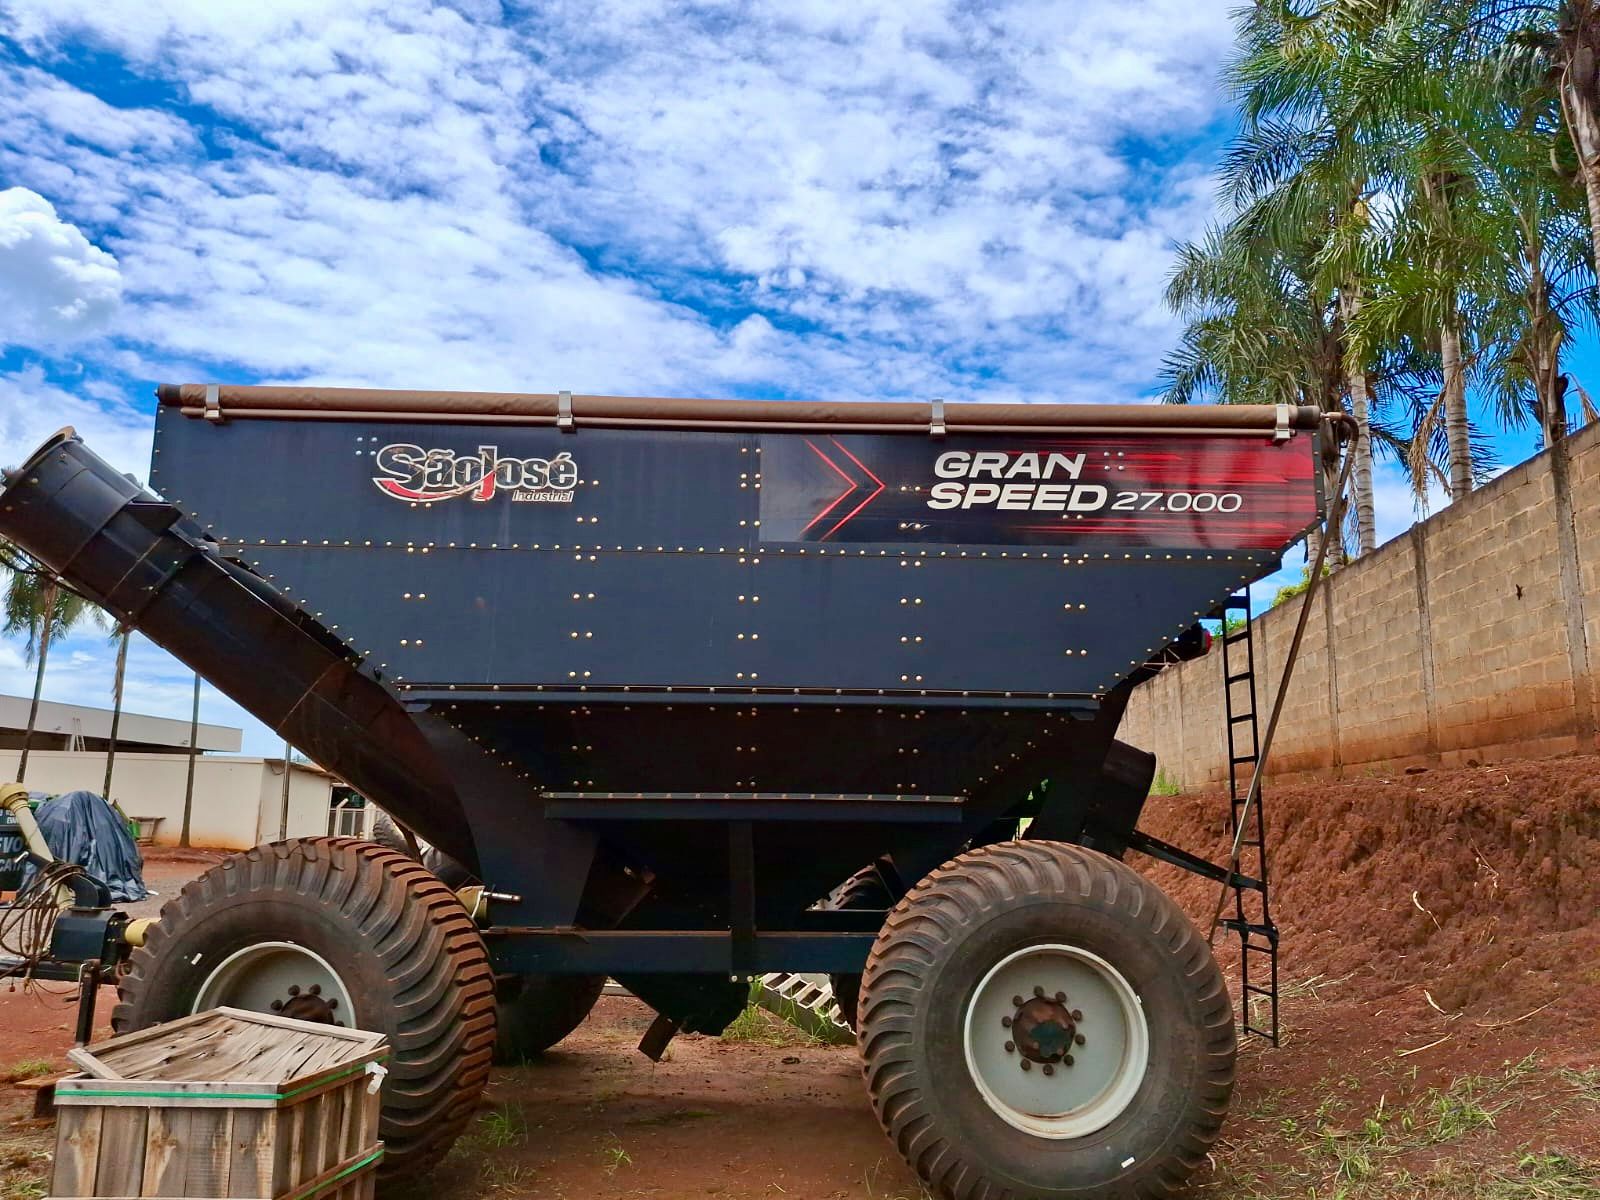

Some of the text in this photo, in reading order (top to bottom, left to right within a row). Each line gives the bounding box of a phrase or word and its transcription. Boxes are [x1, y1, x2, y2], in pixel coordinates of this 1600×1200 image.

[933, 450, 1087, 479] GRAN
[511, 489, 575, 503] Industrial
[926, 482, 1243, 513] SPEED 27.000
